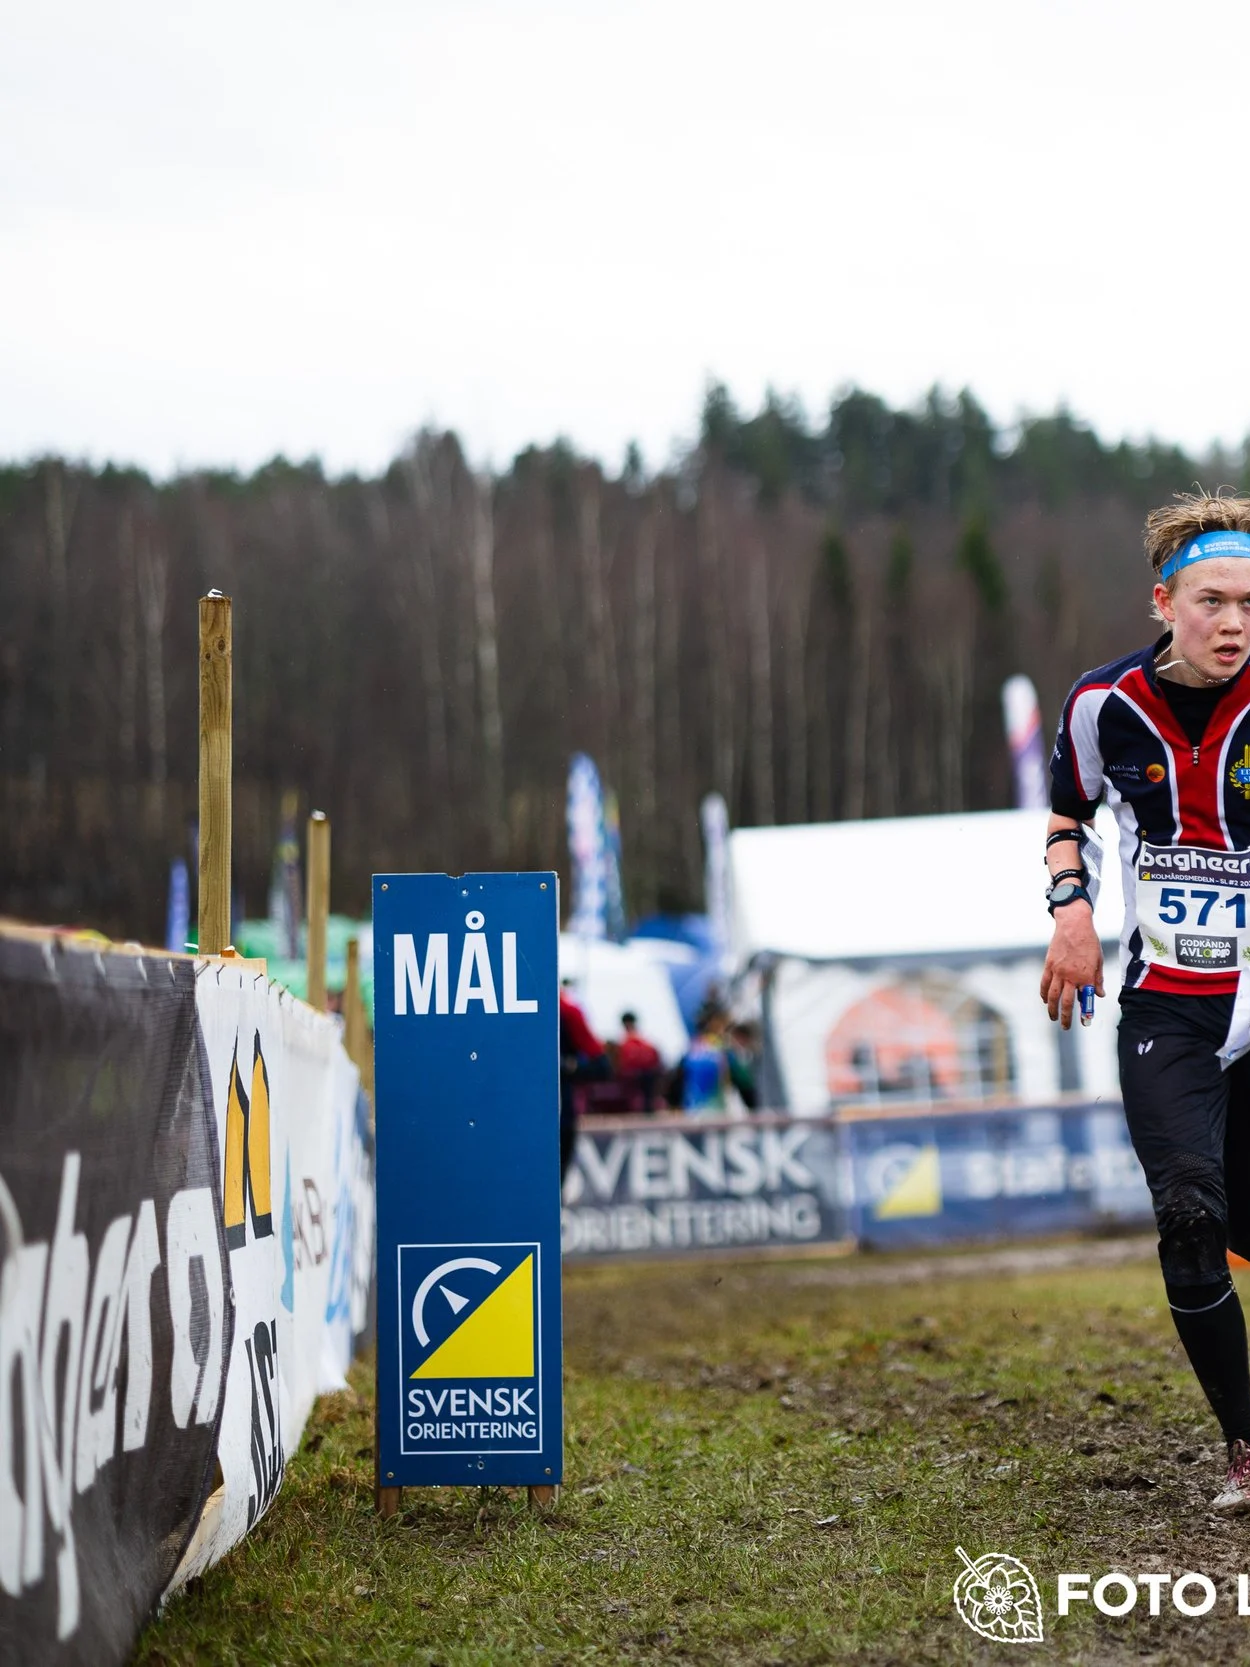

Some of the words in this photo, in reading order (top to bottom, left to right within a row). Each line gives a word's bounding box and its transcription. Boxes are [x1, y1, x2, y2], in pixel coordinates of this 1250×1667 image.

[1151, 872, 1215, 883] KOLMÅRDSMEDELN
[1158, 887, 1247, 929] 571
[1180, 938, 1231, 949] GODKÄNDA
[393, 910, 538, 1015] MÅL
[408, 1387, 536, 1418] SVENSK
[407, 1421, 537, 1440] ORIENTERING
